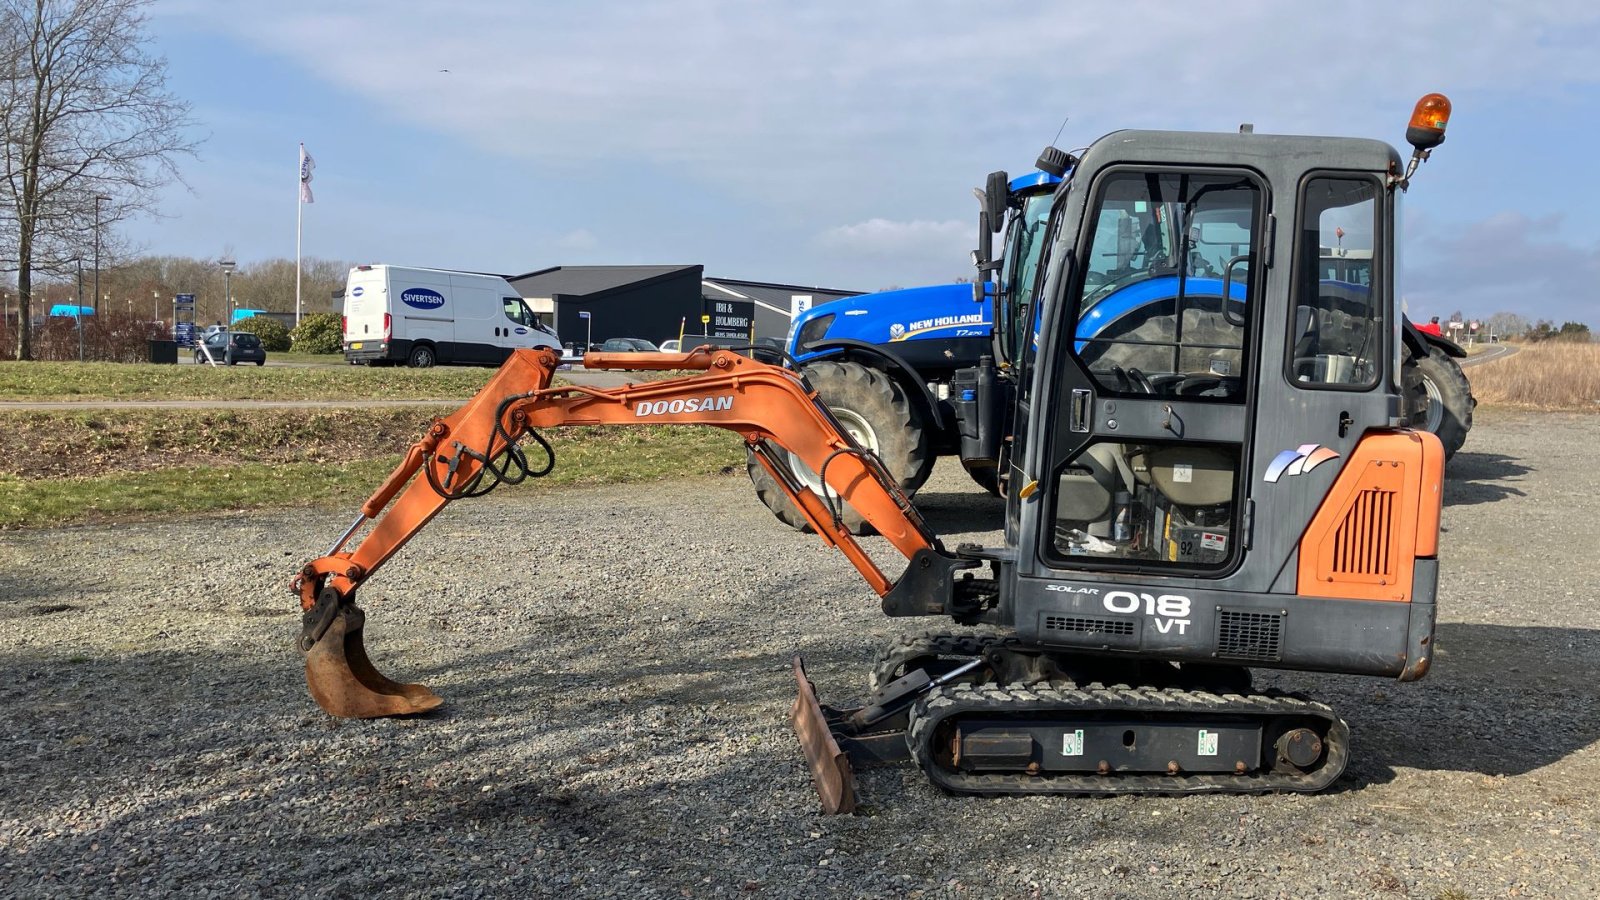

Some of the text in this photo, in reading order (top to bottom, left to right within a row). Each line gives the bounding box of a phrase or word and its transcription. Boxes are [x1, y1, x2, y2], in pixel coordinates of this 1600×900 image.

[403, 293, 443, 304] SIVERTSEN
[727, 303, 733, 313] &
[715, 316, 748, 328] HOLMBERG
[909, 314, 981, 331] NEW HOLLAND
[635, 396, 734, 417] DOOSAN
[1180, 541, 1193, 555] 92
[1045, 584, 1099, 595] SOLAR
[1103, 591, 1191, 618] 018
[1155, 617, 1191, 635] VT
